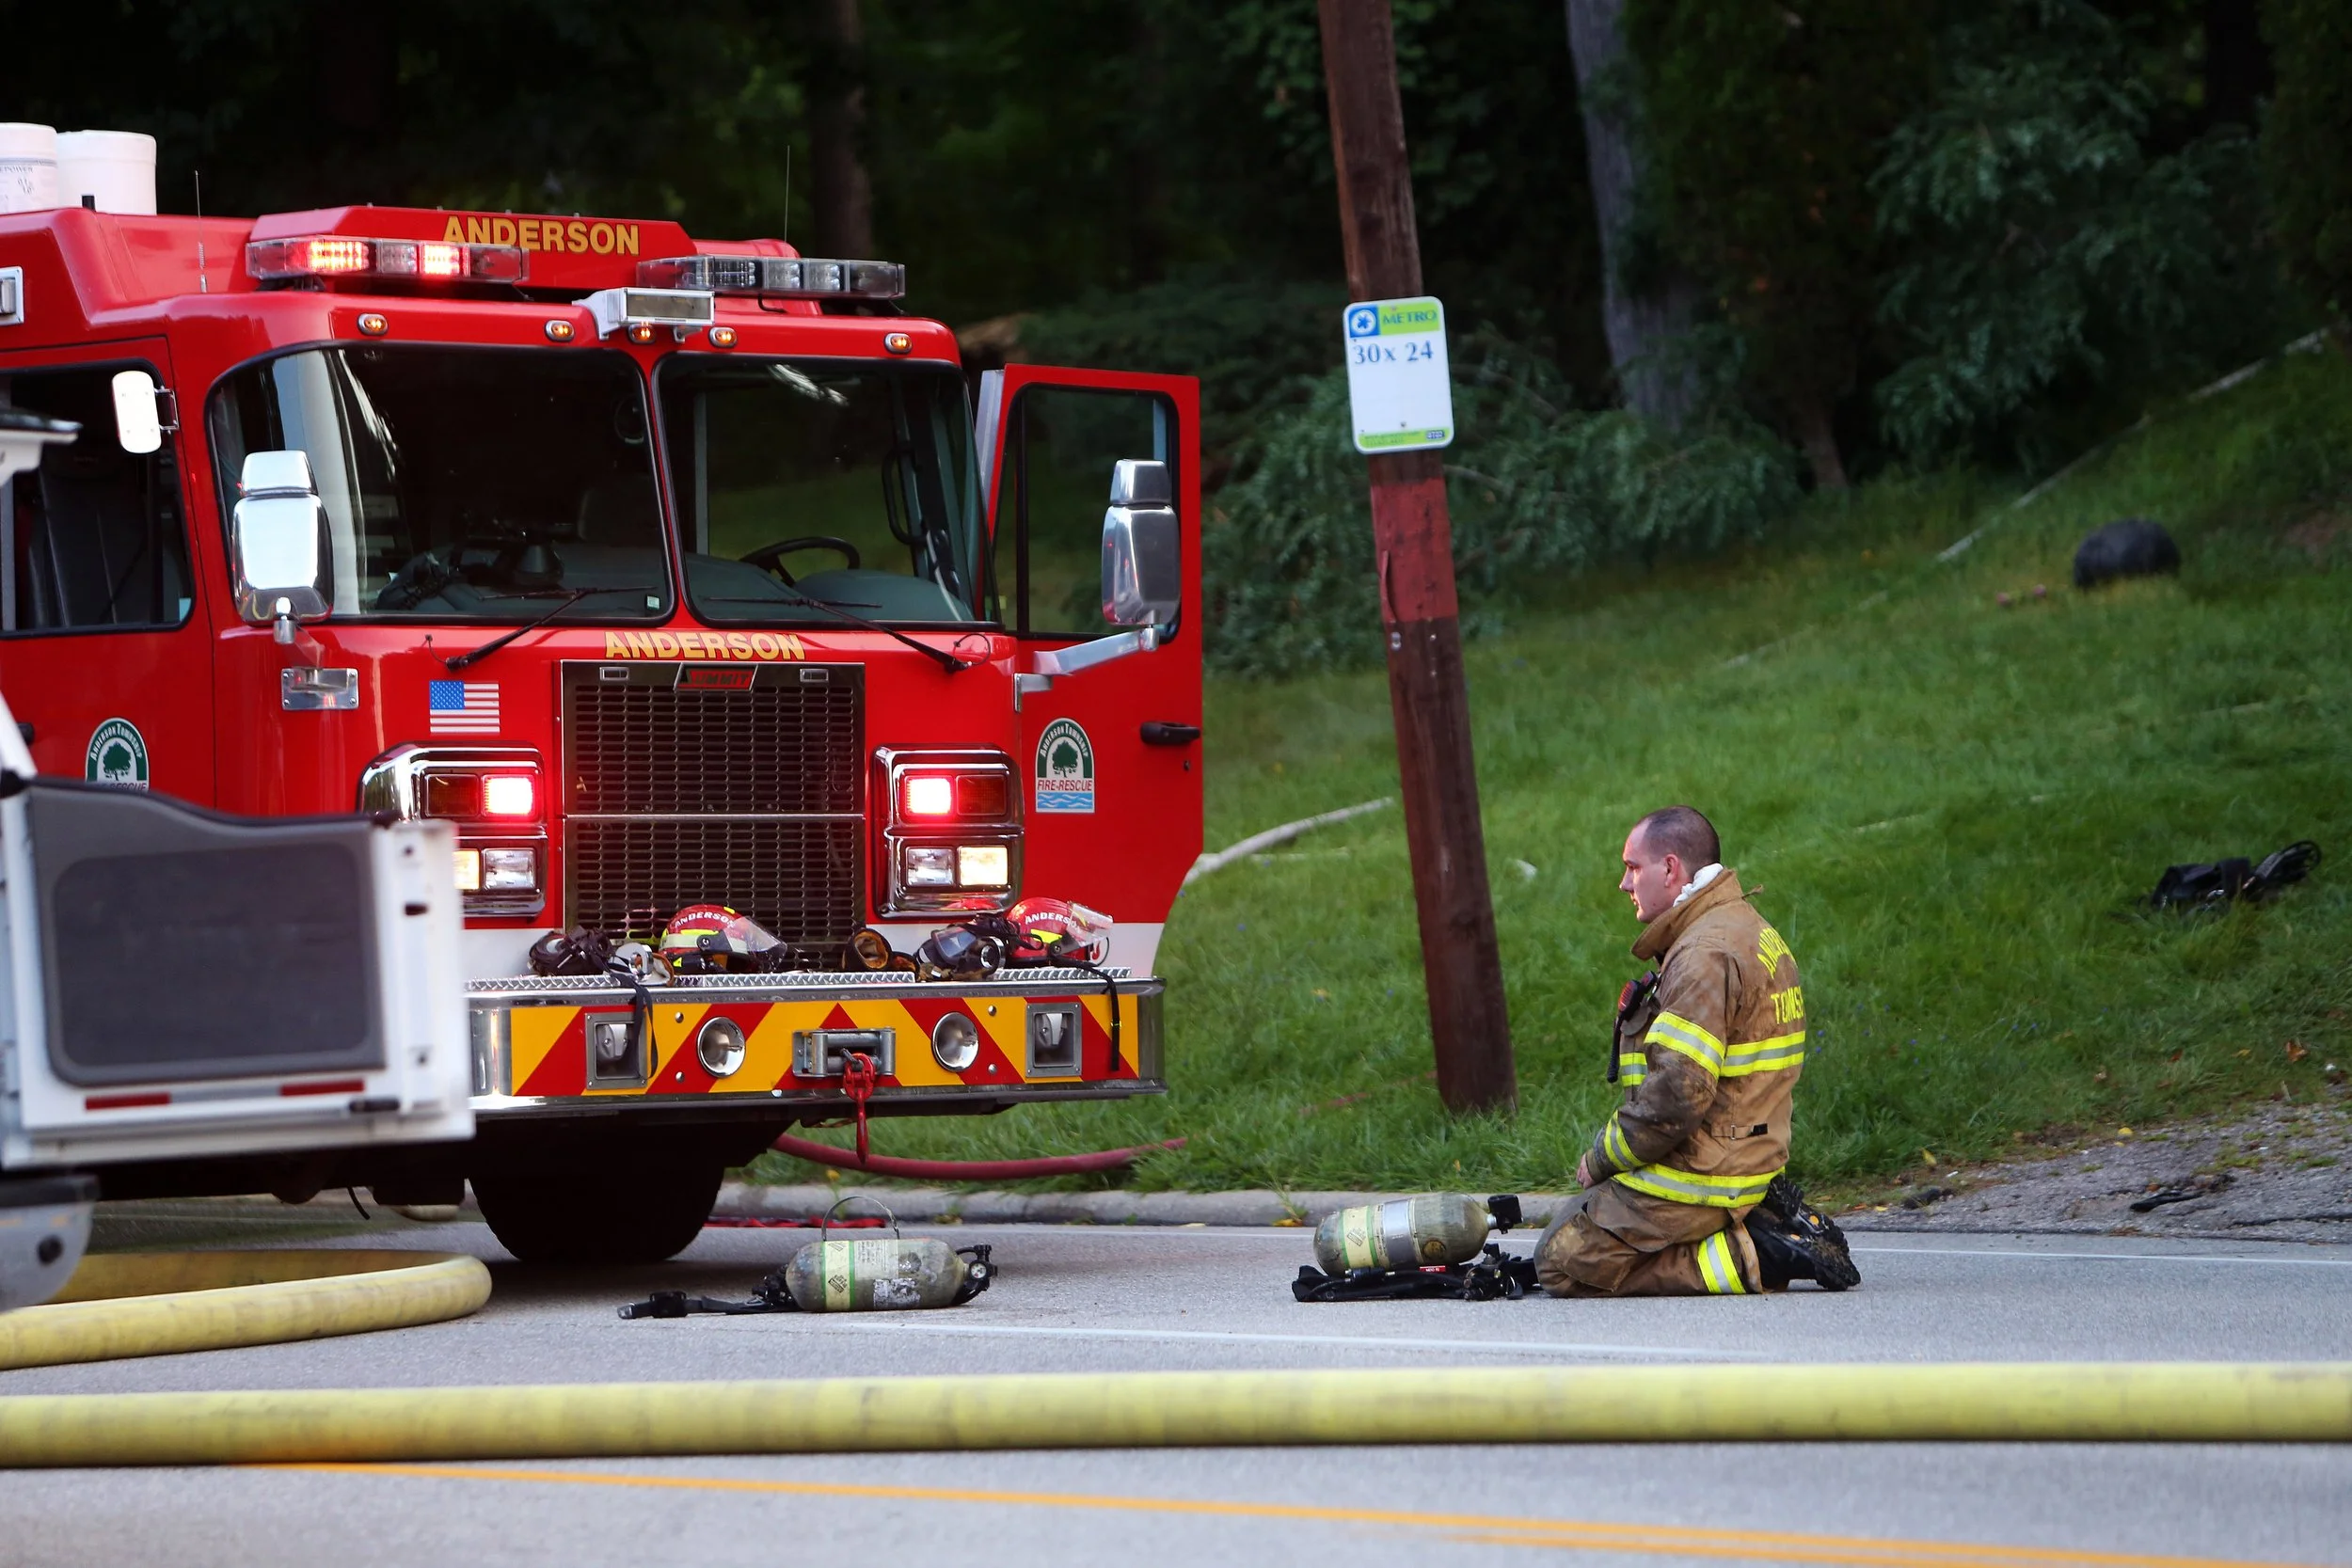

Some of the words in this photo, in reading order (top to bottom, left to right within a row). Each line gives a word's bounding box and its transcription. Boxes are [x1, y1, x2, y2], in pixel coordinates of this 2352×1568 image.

[443, 215, 640, 256] ANDERSON
[1383, 310, 1438, 325] METRO
[1406, 340, 1434, 361] 24
[604, 631, 805, 660] ANDERSON
[1037, 780, 1092, 791] FIRE-RESCUE
